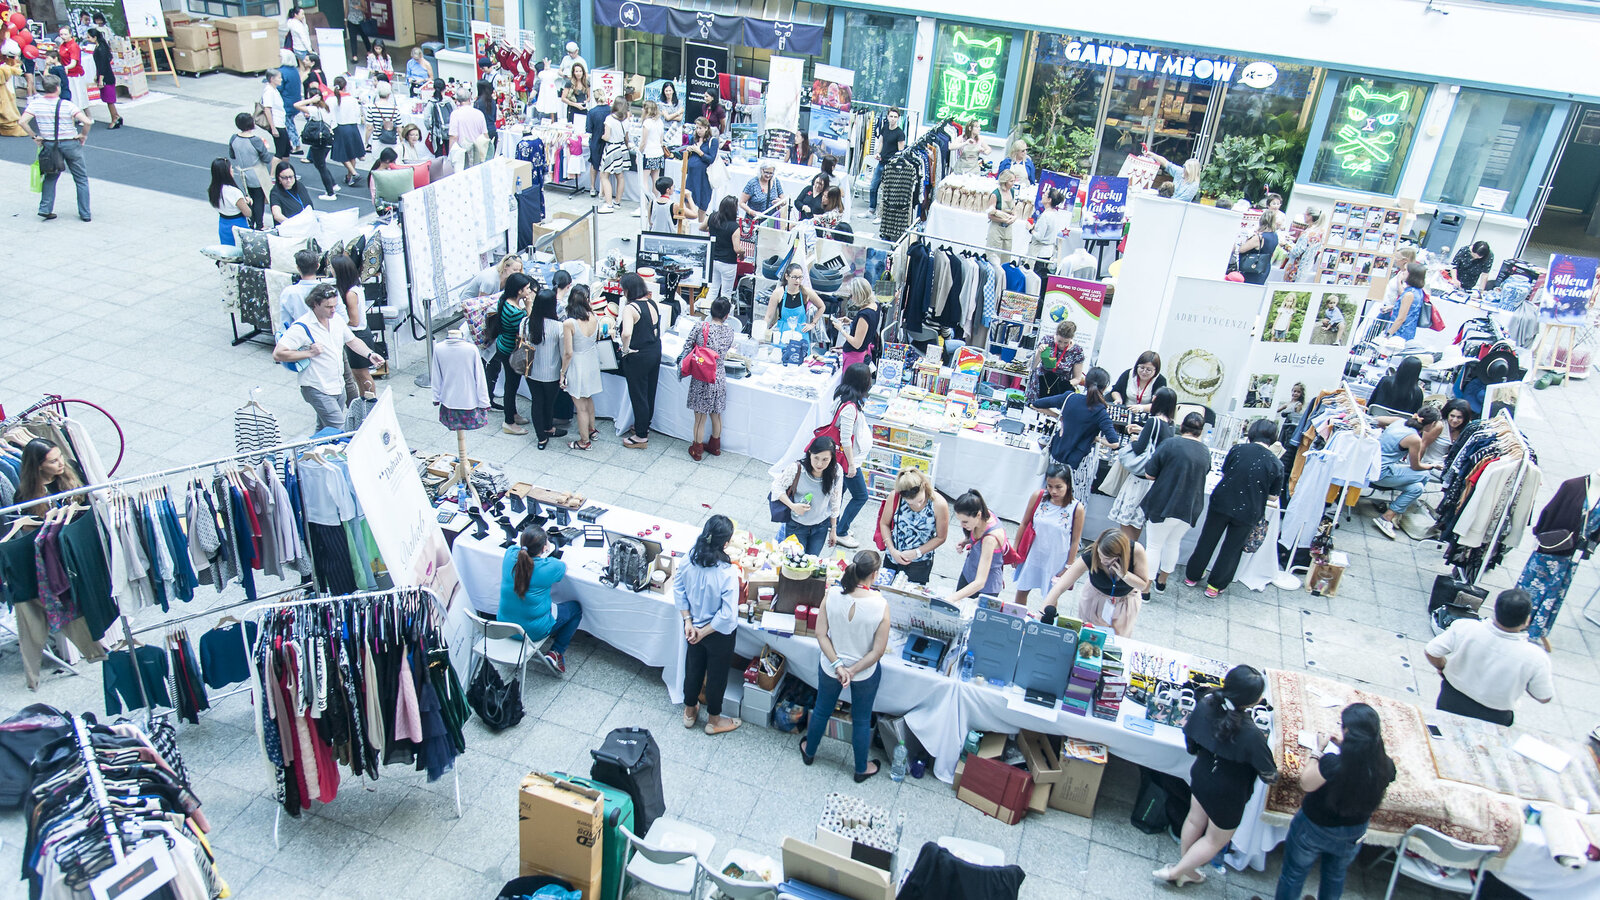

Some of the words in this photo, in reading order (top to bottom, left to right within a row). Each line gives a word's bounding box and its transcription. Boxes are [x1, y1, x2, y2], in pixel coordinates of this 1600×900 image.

[1065, 41, 1158, 71] GARDEN
[1161, 54, 1237, 81] MEOW
[690, 79, 719, 88] BOHOBETTY
[1341, 154, 1372, 176] Cafe
[1090, 189, 1123, 203] Lucky
[1552, 273, 1588, 287] Silent
[1550, 285, 1591, 299] Auction
[1174, 312, 1199, 323] ADRY
[1202, 314, 1248, 330] VINCENZI
